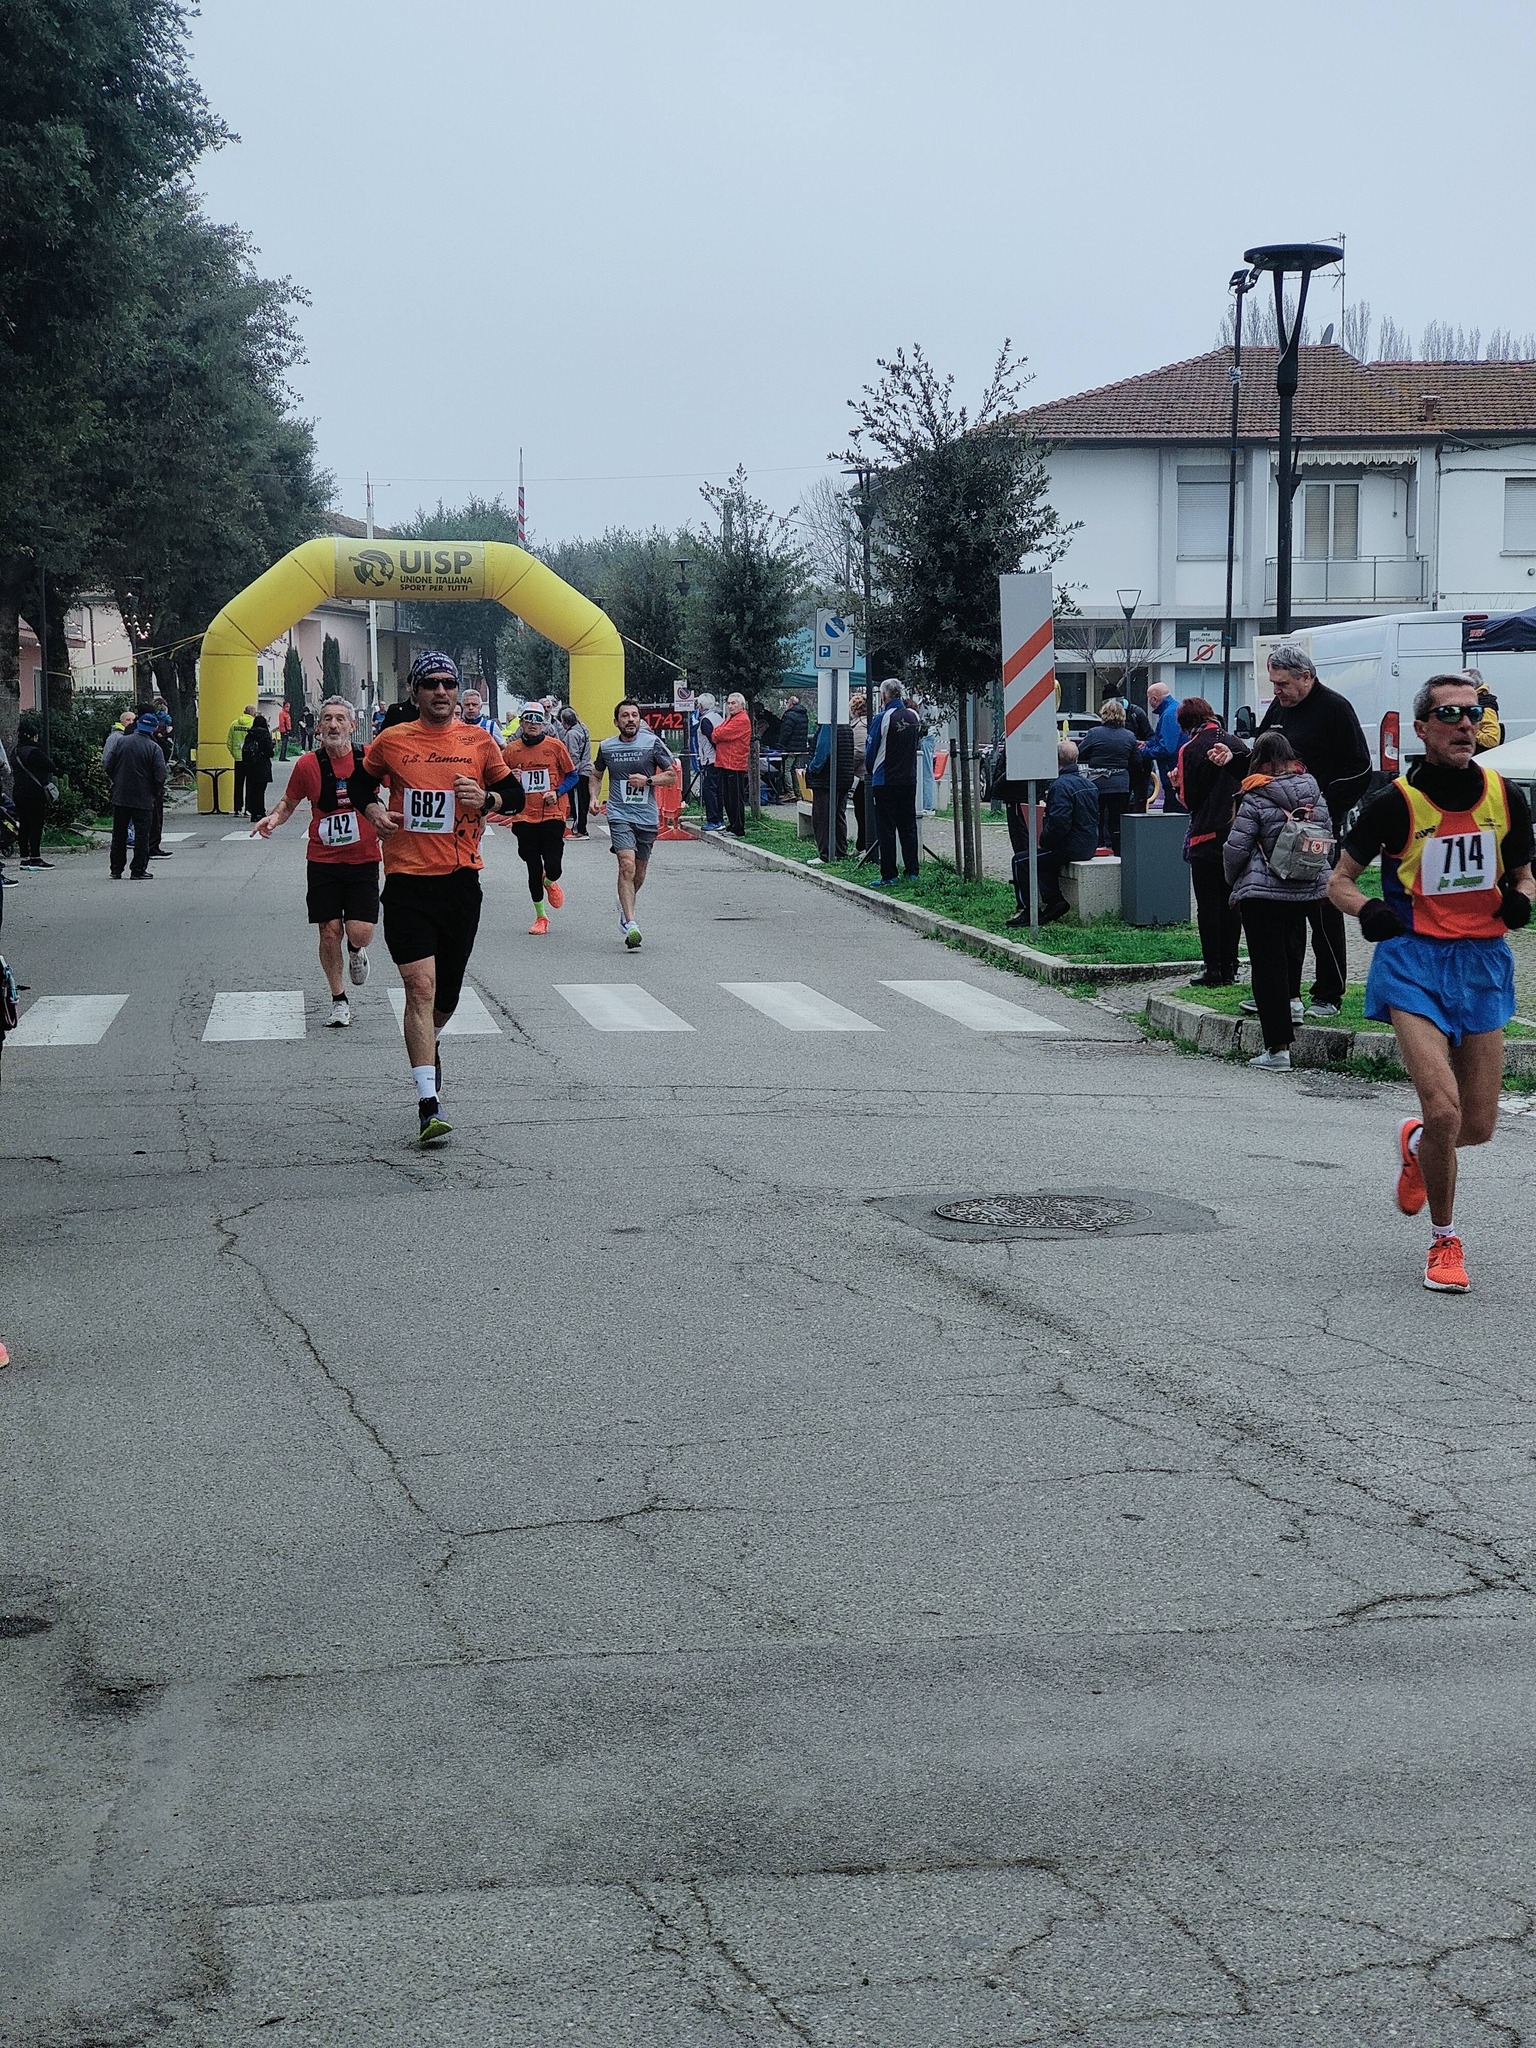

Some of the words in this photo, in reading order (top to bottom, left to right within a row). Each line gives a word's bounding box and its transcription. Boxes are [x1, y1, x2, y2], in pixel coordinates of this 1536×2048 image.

[400, 550, 473, 575] UISP
[400, 576, 433, 584] UNIONE
[436, 577, 473, 585] ITALIANA
[400, 584, 427, 592] SPORT
[820, 646, 829, 657] P
[644, 712, 684, 729] 17:42
[424, 752, 473, 765] Lamone
[527, 770, 545, 786] 797
[411, 790, 446, 819] 682
[1441, 834, 1485, 874] 714
